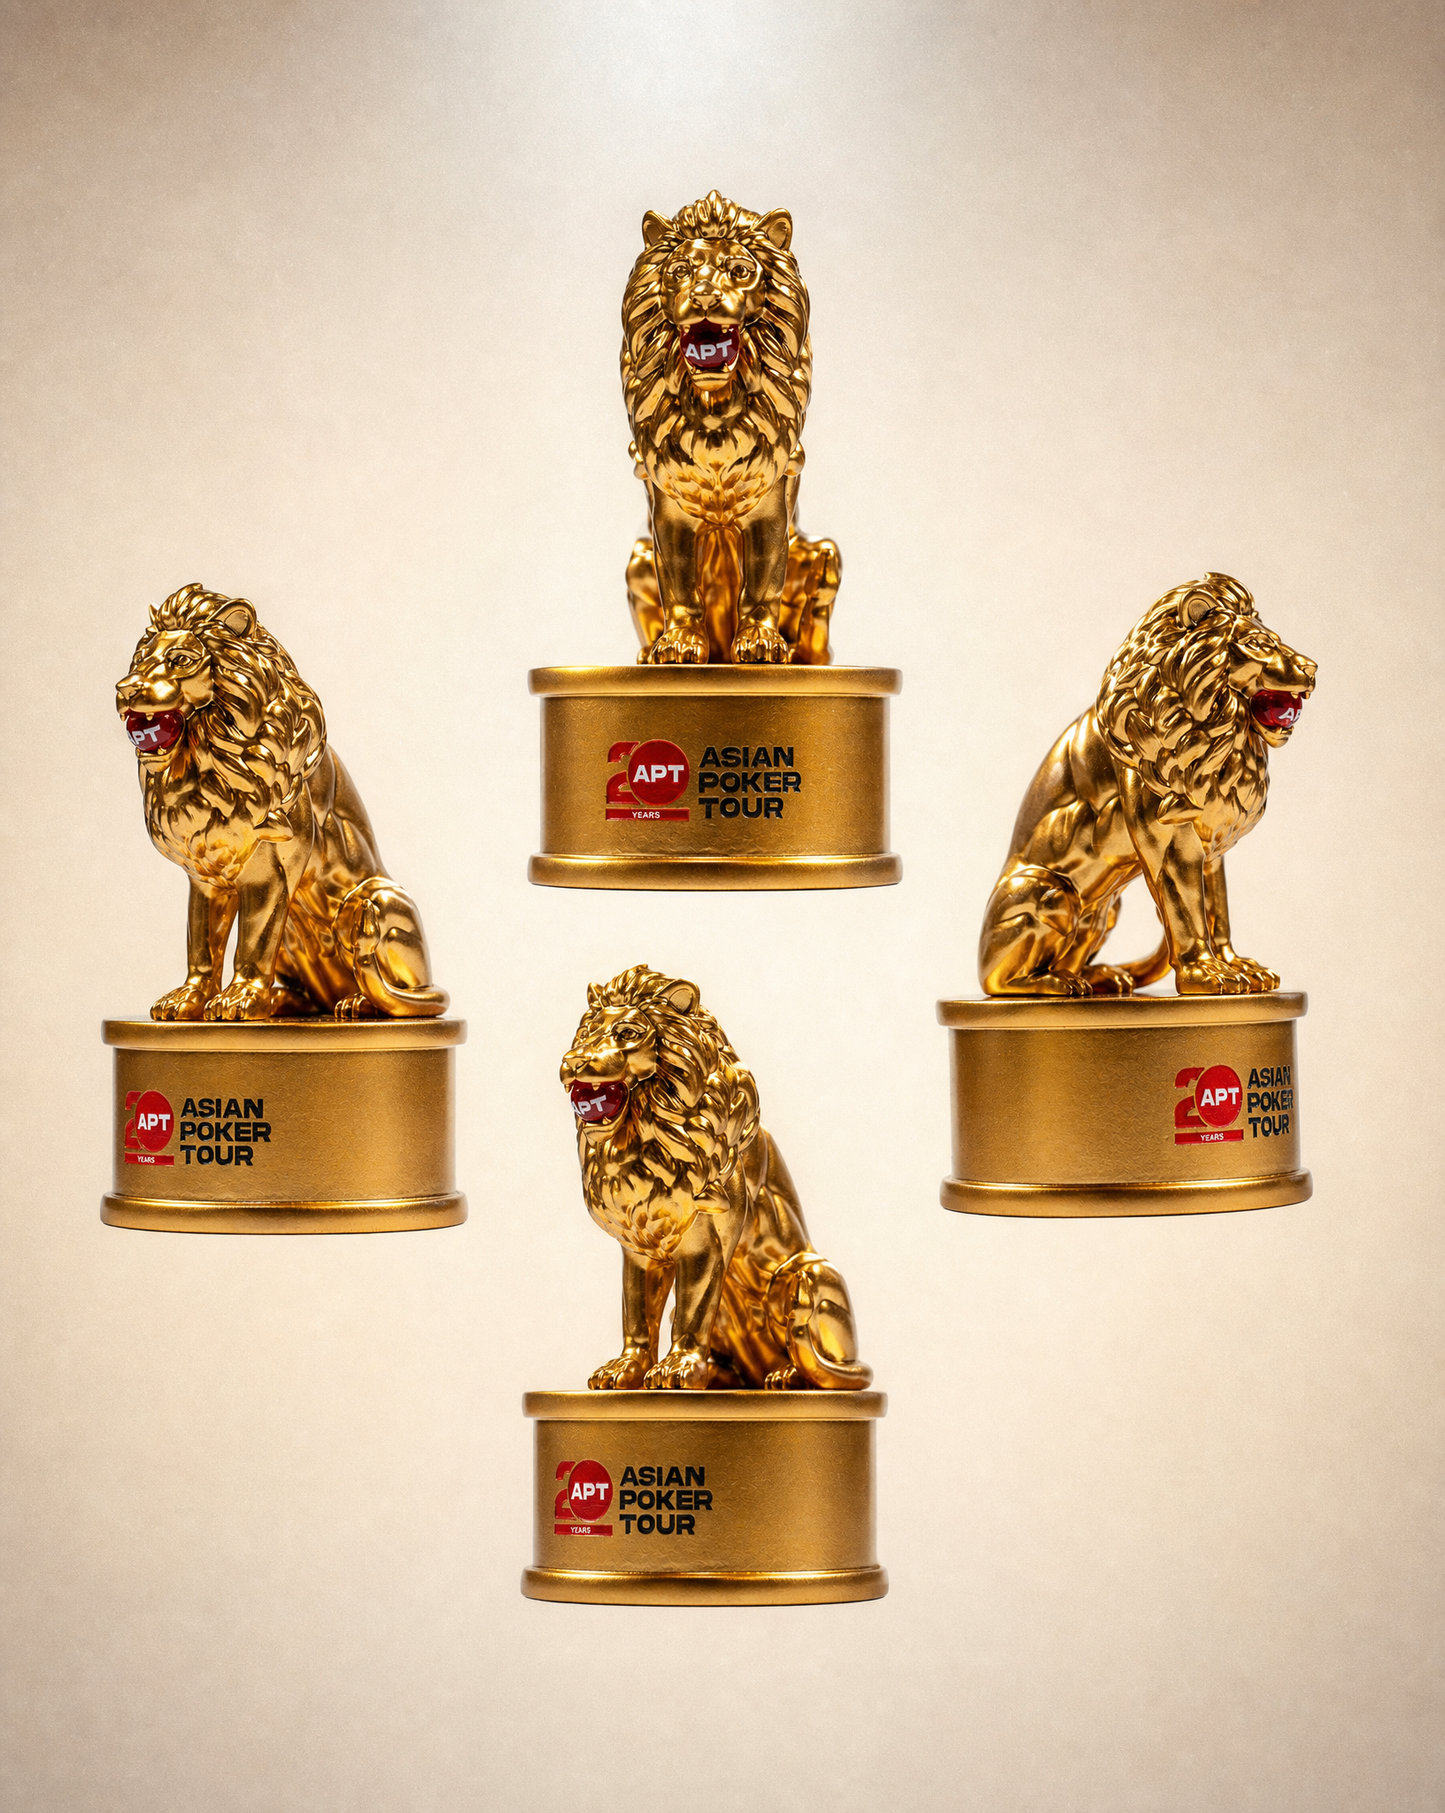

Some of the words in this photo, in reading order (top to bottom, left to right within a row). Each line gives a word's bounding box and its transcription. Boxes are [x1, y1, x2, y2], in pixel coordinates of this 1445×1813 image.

[685, 339, 732, 360] APT
[698, 746, 794, 768] ASIAN
[632, 764, 685, 783] APT
[698, 771, 802, 794] POKER
[631, 811, 661, 819] YEARS
[698, 796, 784, 819] TOUR
[1247, 1065, 1291, 1090] ASIAN
[180, 1097, 264, 1119] ASIAN
[1200, 1087, 1240, 1107] APT
[1247, 1088, 1294, 1114] POKER
[137, 1112, 171, 1131] APT
[179, 1121, 272, 1143] POKER
[1247, 1113, 1290, 1139] TOUR
[1200, 1132, 1224, 1142] YEARS
[137, 1155, 155, 1164] YEARS
[179, 1144, 254, 1166] TOUR
[619, 1465, 705, 1487] ASIAN
[570, 1482, 609, 1501] APT
[619, 1489, 713, 1511] POKER
[619, 1513, 696, 1535] TOUR
